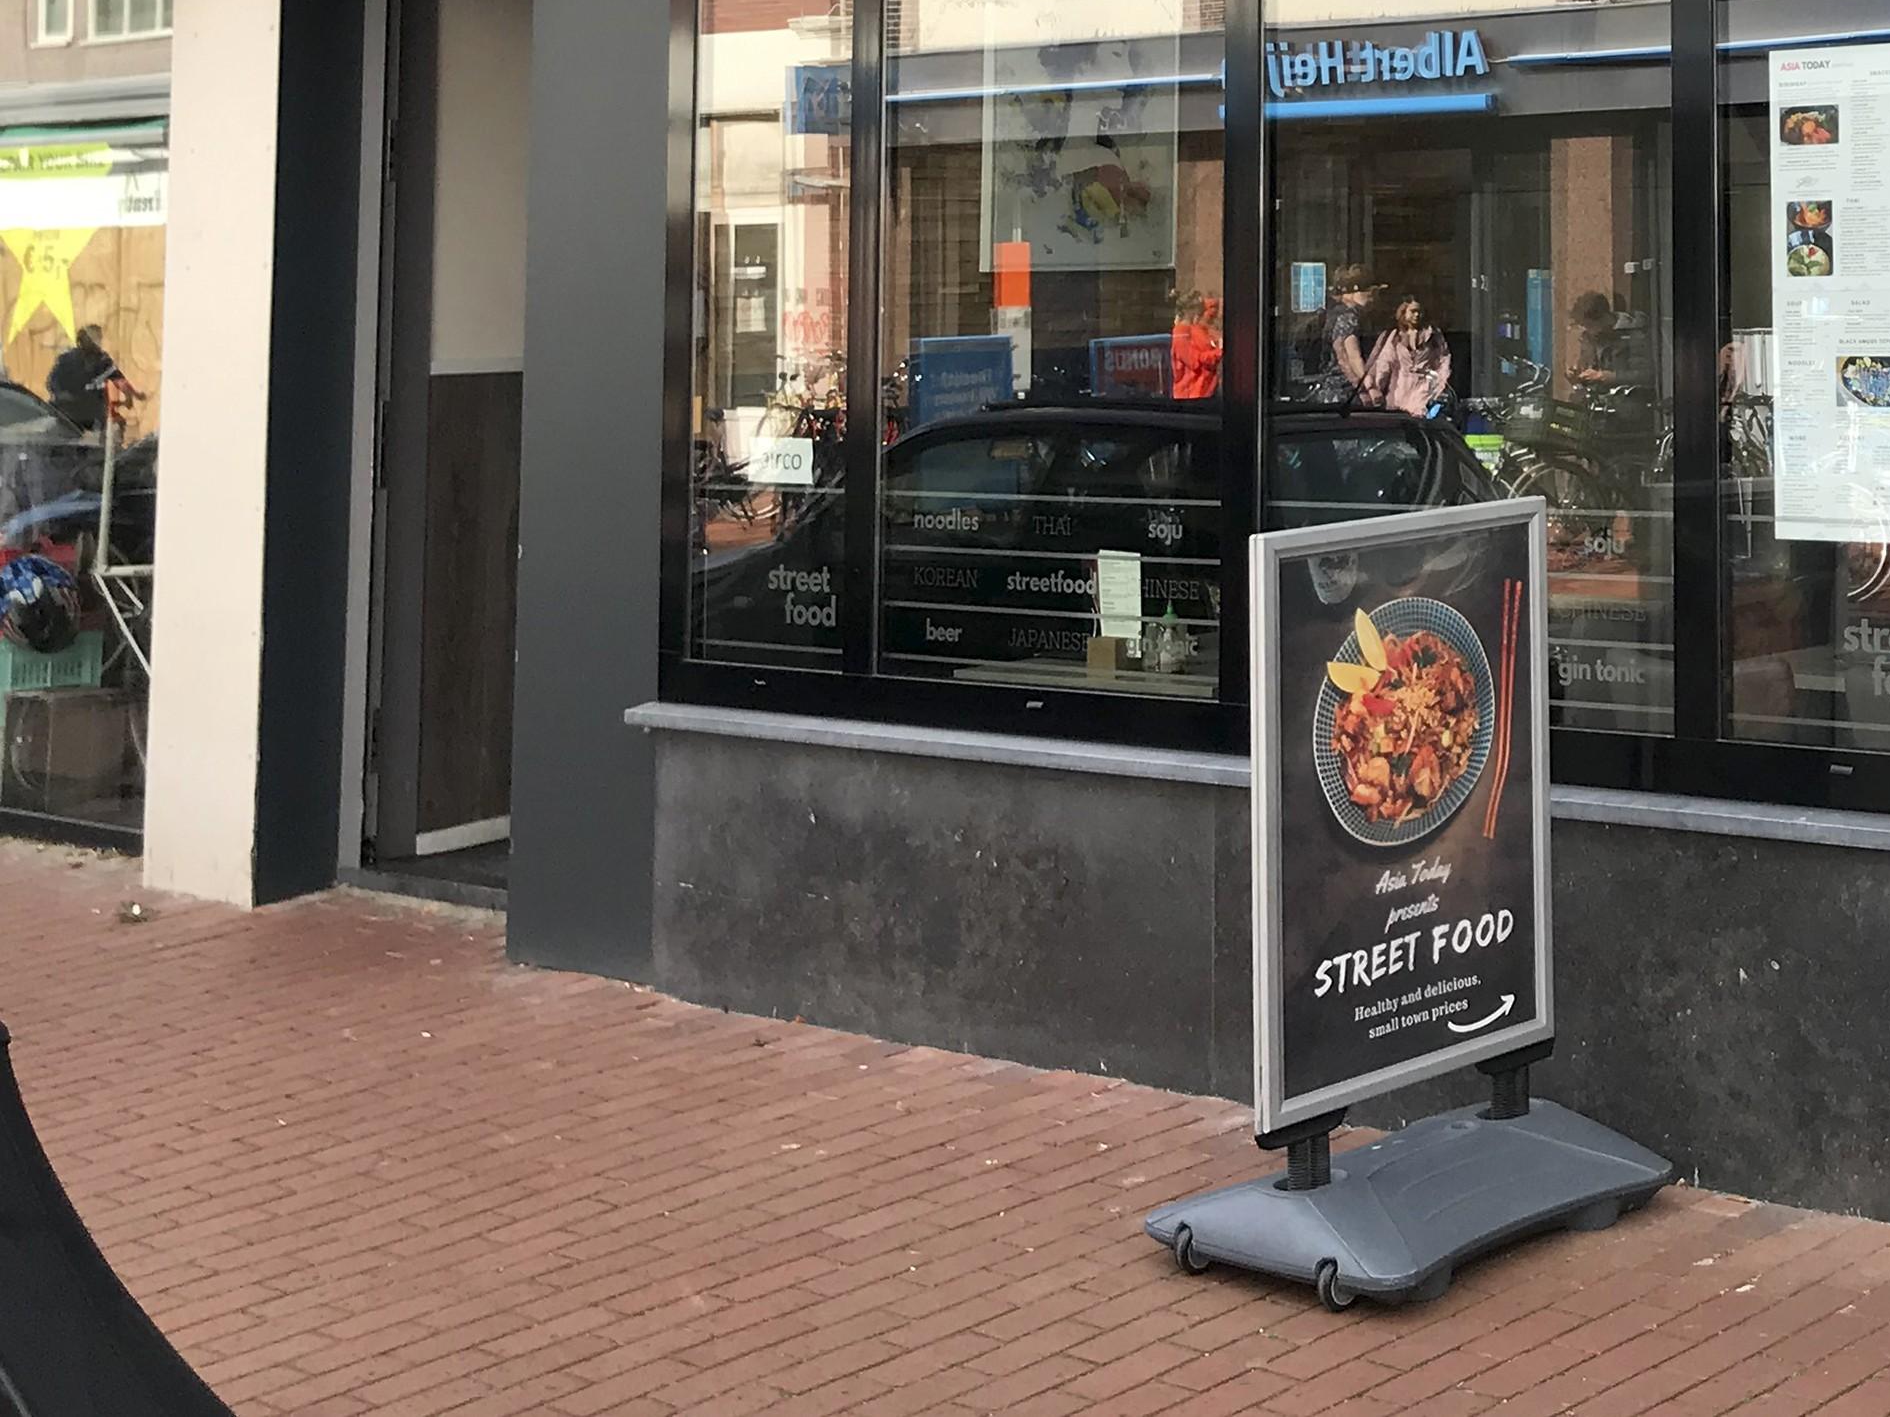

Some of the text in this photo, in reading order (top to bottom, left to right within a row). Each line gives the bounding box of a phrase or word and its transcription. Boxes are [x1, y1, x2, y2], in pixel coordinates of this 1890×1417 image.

[1780, 62, 1800, 71] ASIA
[1802, 60, 1831, 70] TODAY
[762, 451, 801, 469] airco
[914, 508, 980, 531] noodles
[1148, 520, 1183, 546] soju
[1584, 529, 1625, 560] soju
[768, 564, 831, 593] street
[914, 566, 978, 588] KOREAN
[1007, 570, 1096, 595] streetfood
[1142, 578, 1201, 601] HINESE
[784, 592, 837, 627] food
[926, 618, 962, 643] beer
[1007, 629, 1090, 653] JAPANESE
[1558, 654, 1645, 686] gin tonic
[1375, 855, 1451, 895] Asia Today
[1385, 893, 1440, 934] presents
[1313, 909, 1514, 998] STREET FOOD
[1354, 997, 1399, 1022] Healthy
[1401, 987, 1422, 1006] and
[1369, 997, 1469, 1039] small town prices
